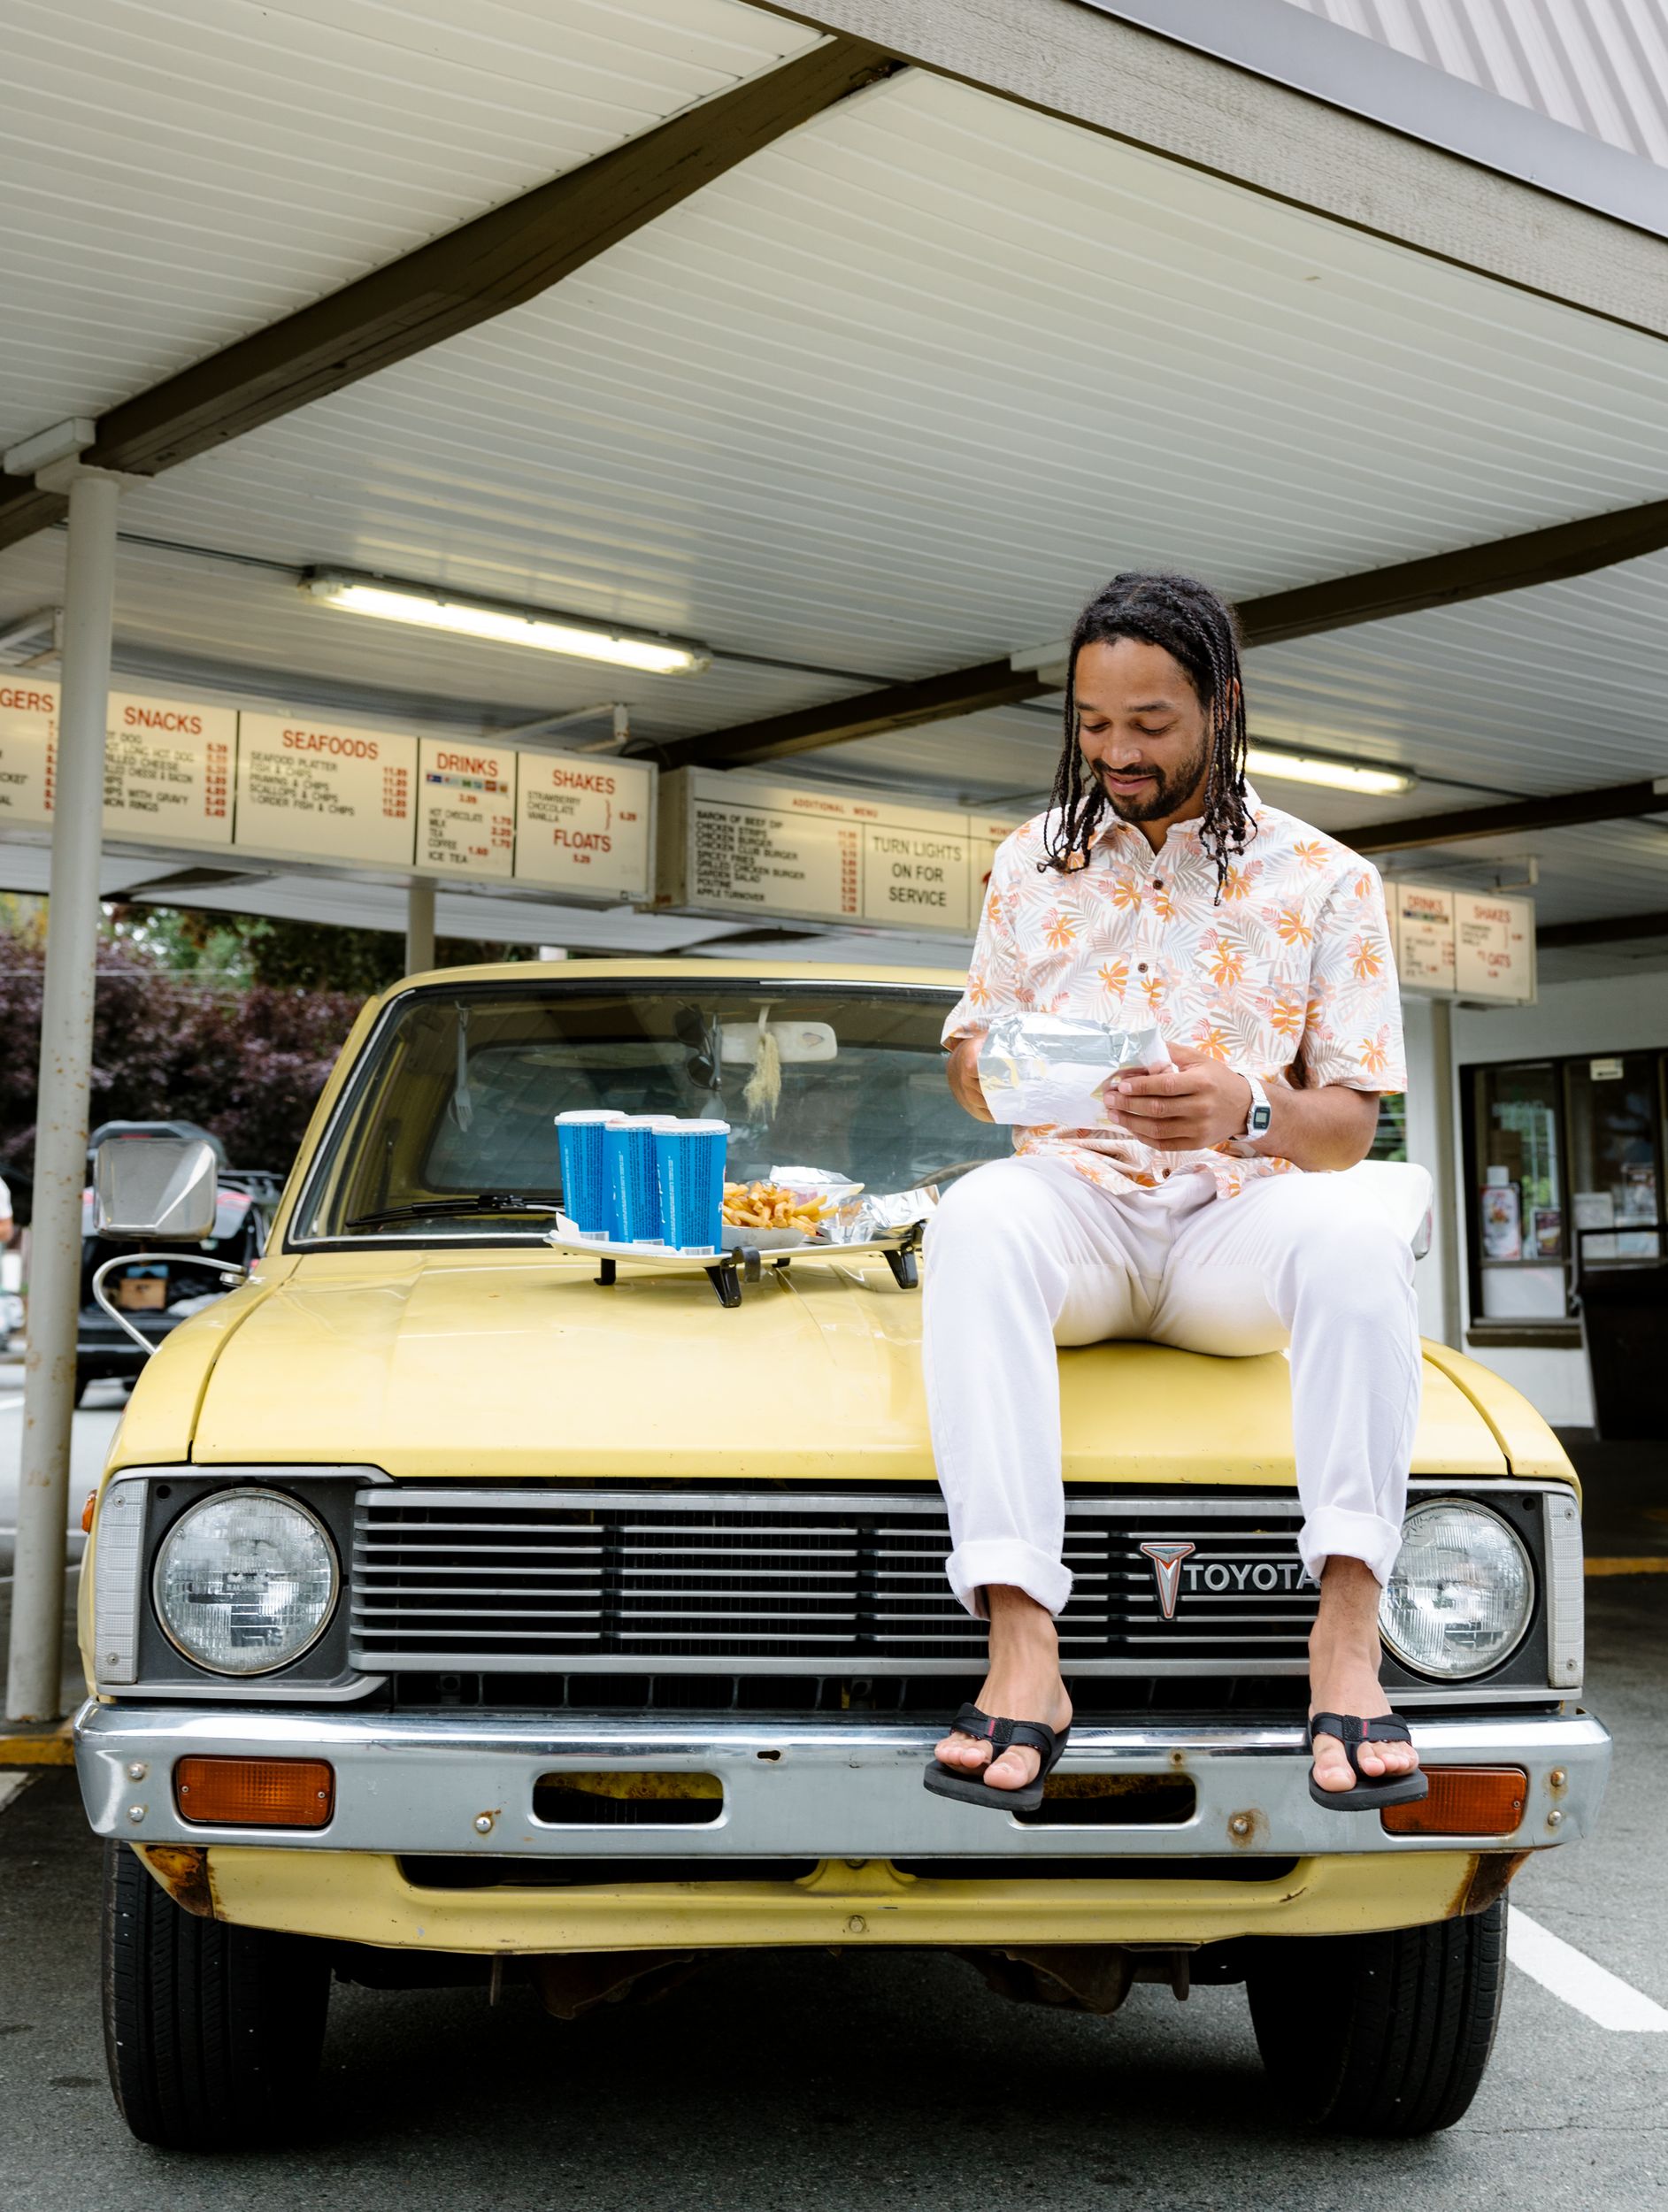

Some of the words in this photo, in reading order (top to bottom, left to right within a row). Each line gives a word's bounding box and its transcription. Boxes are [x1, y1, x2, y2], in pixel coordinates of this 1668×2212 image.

[124, 706, 202, 734] SNACKS
[283, 730, 378, 759] SEAFOODS
[250, 751, 294, 766] SEAFOOD
[437, 752, 497, 778] DRINKS
[552, 769, 616, 795] SHAKES
[696, 810, 726, 822] BARON
[793, 798, 844, 814] ADDITIONAL
[852, 806, 878, 818] MENU
[553, 828, 611, 853] FLOATS
[738, 837, 773, 848] BURGER
[873, 837, 909, 854] TURN
[914, 841, 962, 861] LIGHTS
[428, 851, 445, 862] ICE
[450, 852, 468, 864] TEA
[764, 849, 798, 861] BURGER
[773, 870, 805, 879] BURGER
[892, 863, 912, 879] ON
[916, 865, 944, 882] FOR
[696, 878, 731, 888] POUTINE
[696, 887, 721, 898] APPLE
[888, 887, 947, 907] SERVICE
[1473, 906, 1511, 923] SHAKES
[1183, 1563, 1321, 1591] TOYOTA
